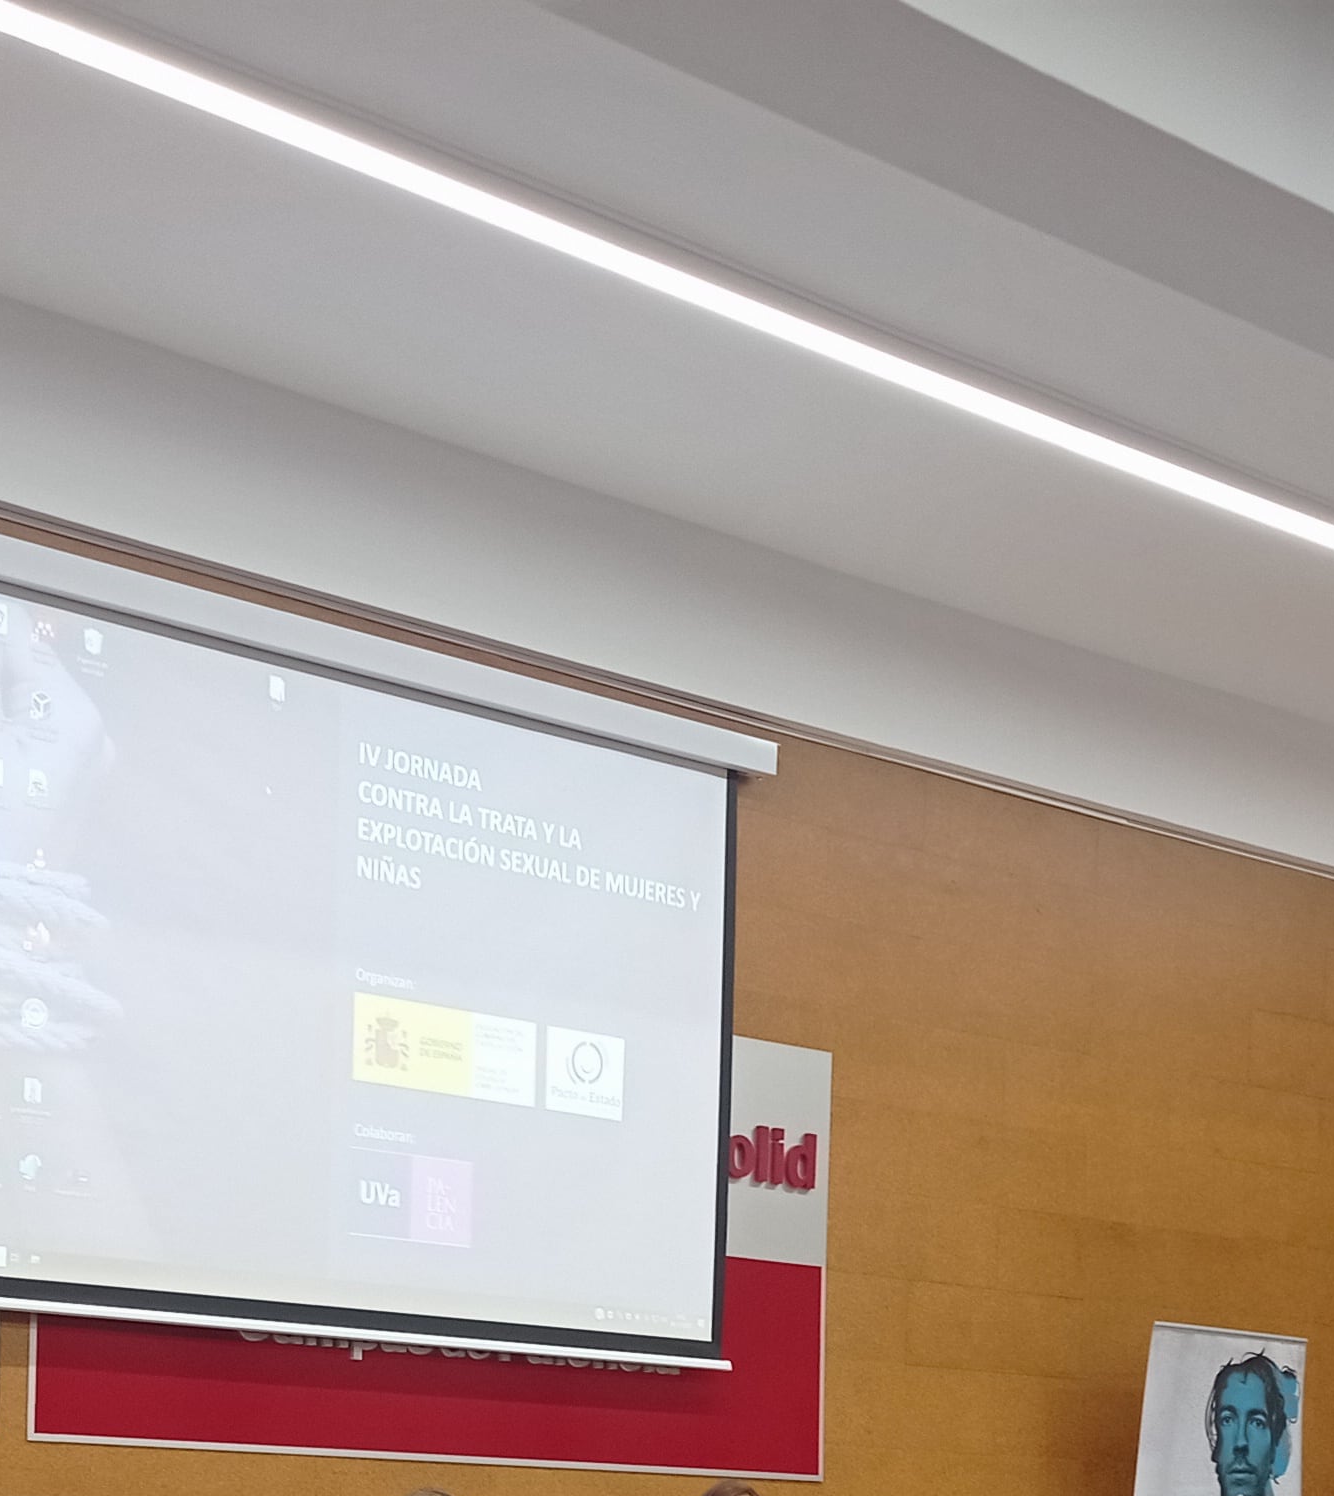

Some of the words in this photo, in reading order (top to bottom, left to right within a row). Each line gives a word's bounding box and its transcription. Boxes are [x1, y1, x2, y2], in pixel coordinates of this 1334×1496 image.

[359, 742, 381, 767] IV
[385, 749, 482, 791] JORNADA
[358, 780, 443, 819] CONTRA
[448, 800, 473, 826] LA
[478, 807, 537, 841] TRATA
[542, 821, 555, 844] Y
[559, 824, 582, 850] LA
[357, 817, 494, 866] EXPLOTACIÓN
[499, 849, 571, 884] SEXUAL
[576, 866, 600, 890] DE
[605, 871, 685, 909] MUJERES
[689, 891, 701, 911] Y
[357, 855, 421, 889] NIÑAS
[360, 1180, 401, 1208] UVa
